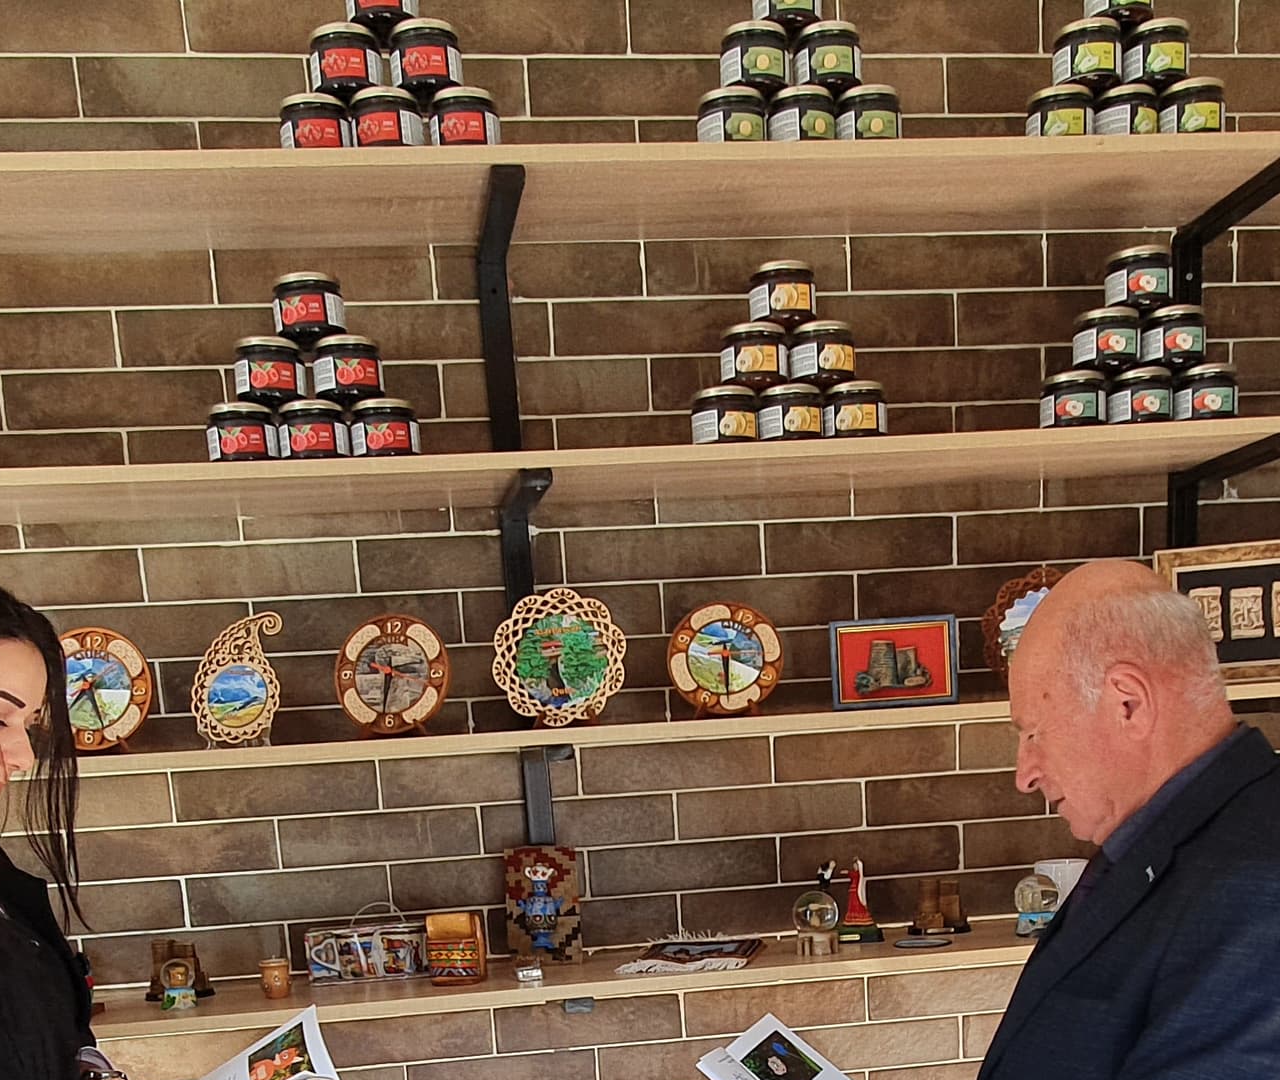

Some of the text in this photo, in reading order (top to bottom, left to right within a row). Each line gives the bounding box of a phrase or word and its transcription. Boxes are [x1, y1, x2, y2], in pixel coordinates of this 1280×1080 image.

[738, 611, 753, 626] 12
[386, 621, 402, 634] 12
[86, 636, 102, 649] 12
[678, 634, 691, 645] 9
[341, 670, 353, 680] 9
[430, 668, 443, 678] 3
[760, 671, 773, 681] 3
[132, 686, 146, 696] 3
[700, 691, 711, 703] 6
[385, 714, 394, 727] 6
[84, 731, 94, 744] 6
